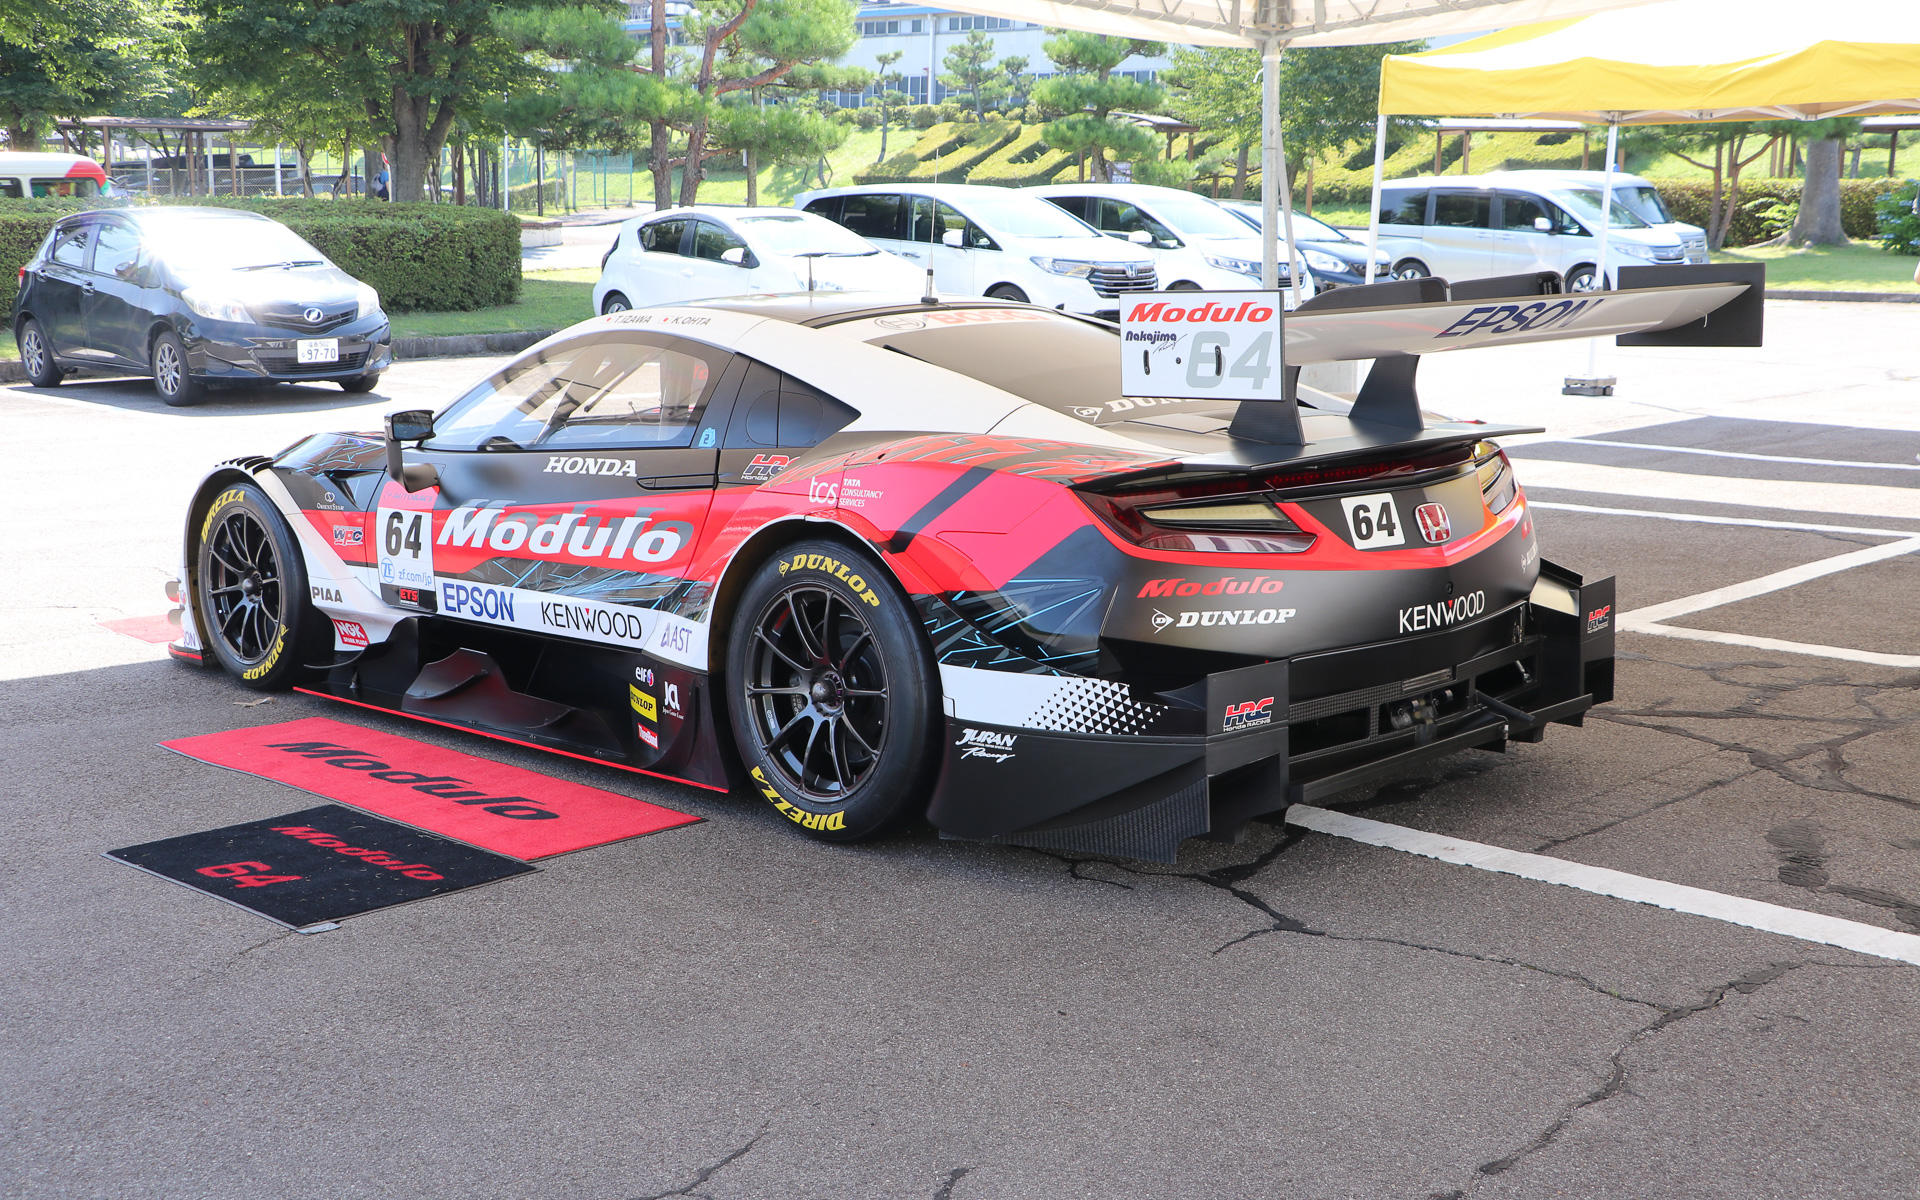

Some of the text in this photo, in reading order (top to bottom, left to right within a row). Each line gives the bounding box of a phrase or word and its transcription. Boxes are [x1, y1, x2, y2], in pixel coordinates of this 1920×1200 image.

[1126, 302, 1274, 323] Modulo
[1433, 298, 1605, 339] EPSON
[1125, 331, 1177, 344] Nakajima
[1186, 330, 1273, 390] 64
[543, 456, 638, 477] HONDA
[809, 476, 838, 504] tcs
[841, 488, 883, 499] CONSULTANCY
[843, 478, 861, 487] TATA
[839, 498, 866, 507] SERVICES
[201, 489, 246, 545] DIREZZA
[1352, 501, 1396, 541] 64
[386, 511, 422, 559] 64
[436, 506, 682, 563] Modulo
[398, 568, 433, 586] zf.com/jp
[790, 553, 881, 607] DUNLOP
[1136, 576, 1284, 598] Modulo
[312, 586, 343, 603] PIAA
[400, 588, 418, 602] ETS
[442, 582, 515, 622] EPSON
[541, 600, 642, 640] KENWOOD
[1176, 608, 1297, 628] DUNLOP
[1400, 590, 1485, 634] KENWOOD
[336, 621, 366, 639] NGK
[243, 634, 285, 680] DUNLOP
[630, 690, 654, 712] DUNLOP
[1223, 696, 1275, 728] HRC
[955, 728, 1018, 747] JURAN
[1223, 724, 1247, 732] Honda
[961, 747, 1016, 764] Racing
[262, 741, 560, 820] Modulo
[751, 766, 847, 831] DIREZZA
[269, 826, 445, 881] Modulo
[196, 861, 303, 889] 64
